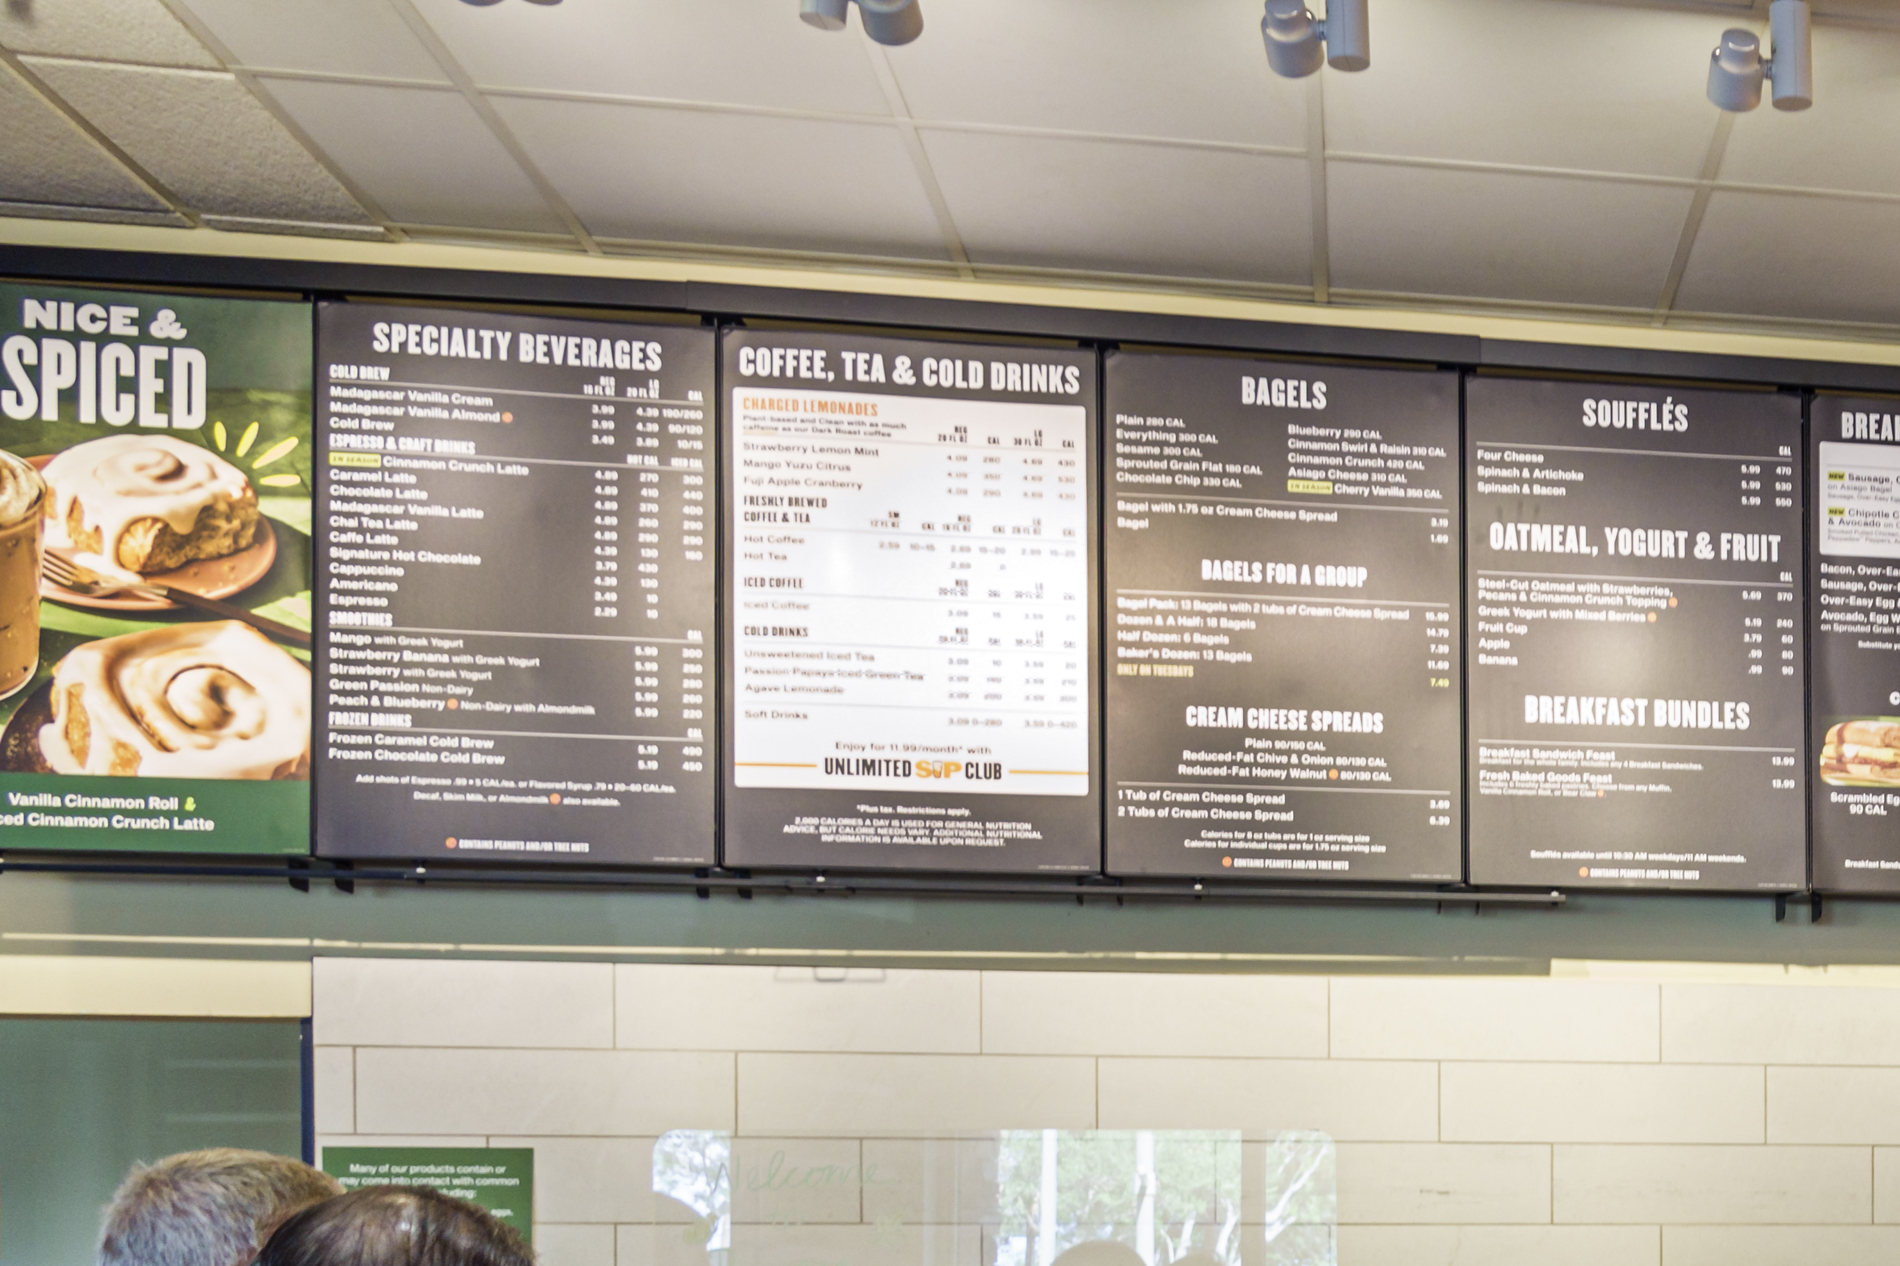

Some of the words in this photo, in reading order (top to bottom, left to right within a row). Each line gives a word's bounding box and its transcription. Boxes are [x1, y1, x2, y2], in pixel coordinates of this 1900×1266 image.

[24, 299, 140, 336] NICE
[150, 308, 187, 341] &
[372, 322, 511, 361] SPECIALTY
[519, 332, 662, 371] BEVERAGES
[330, 365, 357, 379] COLD
[359, 366, 390, 381] BREW
[739, 346, 835, 383] COFFEE,
[841, 351, 886, 384] TEA
[892, 355, 917, 386] &
[922, 357, 983, 390] COLD
[990, 361, 1080, 395] DRINKS
[1, 335, 207, 430] SPICED
[1241, 375, 1327, 410] BAGELS
[743, 397, 799, 413] CHARGED
[803, 399, 878, 417] LEMONADES
[1582, 396, 1688, 432] SOUFFLÉS
[743, 442, 808, 455] Strawberry
[811, 444, 853, 456] Lemon
[855, 446, 880, 457] Mint
[1477, 449, 1502, 462] Four
[1504, 451, 1544, 464] Cheese
[330, 470, 381, 485] Caramel
[384, 472, 417, 486] Latte
[330, 485, 393, 499] Chocolate
[396, 486, 428, 500] Latte
[1489, 521, 1598, 557] OATMEAL,
[1604, 526, 1688, 559] YOGURT
[1693, 531, 1715, 560] &
[1720, 532, 1781, 563] FRUIT
[1202, 558, 1263, 583] BAGELS
[1267, 561, 1297, 584] FOR
[1300, 564, 1311, 585] A
[1315, 564, 1368, 588] GROUP
[330, 594, 388, 608] Espresso
[1478, 638, 1510, 650] Apple
[1478, 654, 1518, 666] Banana
[1117, 663, 1138, 676] ONLY
[1139, 664, 1151, 677] ON
[1153, 664, 1194, 678] TUESDAYS
[1186, 705, 1243, 729] CREAM
[1247, 707, 1308, 731] CHEESE
[1312, 710, 1384, 734] SPREADS
[1524, 694, 1648, 727] BREAKFAST
[1653, 699, 1750, 731] BUNDLES
[824, 757, 911, 778] UNLIMITED
[965, 762, 1002, 780] CLUB
[9, 792, 62, 809] Vanilla
[65, 794, 145, 810] Cinnamon
[148, 795, 179, 811] Roll
[1830, 792, 1885, 805] Scrambled
[349, 1163, 377, 1176] Many
[378, 1163, 389, 1174] of
[390, 1165, 409, 1174] our
[409, 1164, 455, 1176] products
[456, 1164, 494, 1174] contain
[495, 1165, 507, 1174] or
